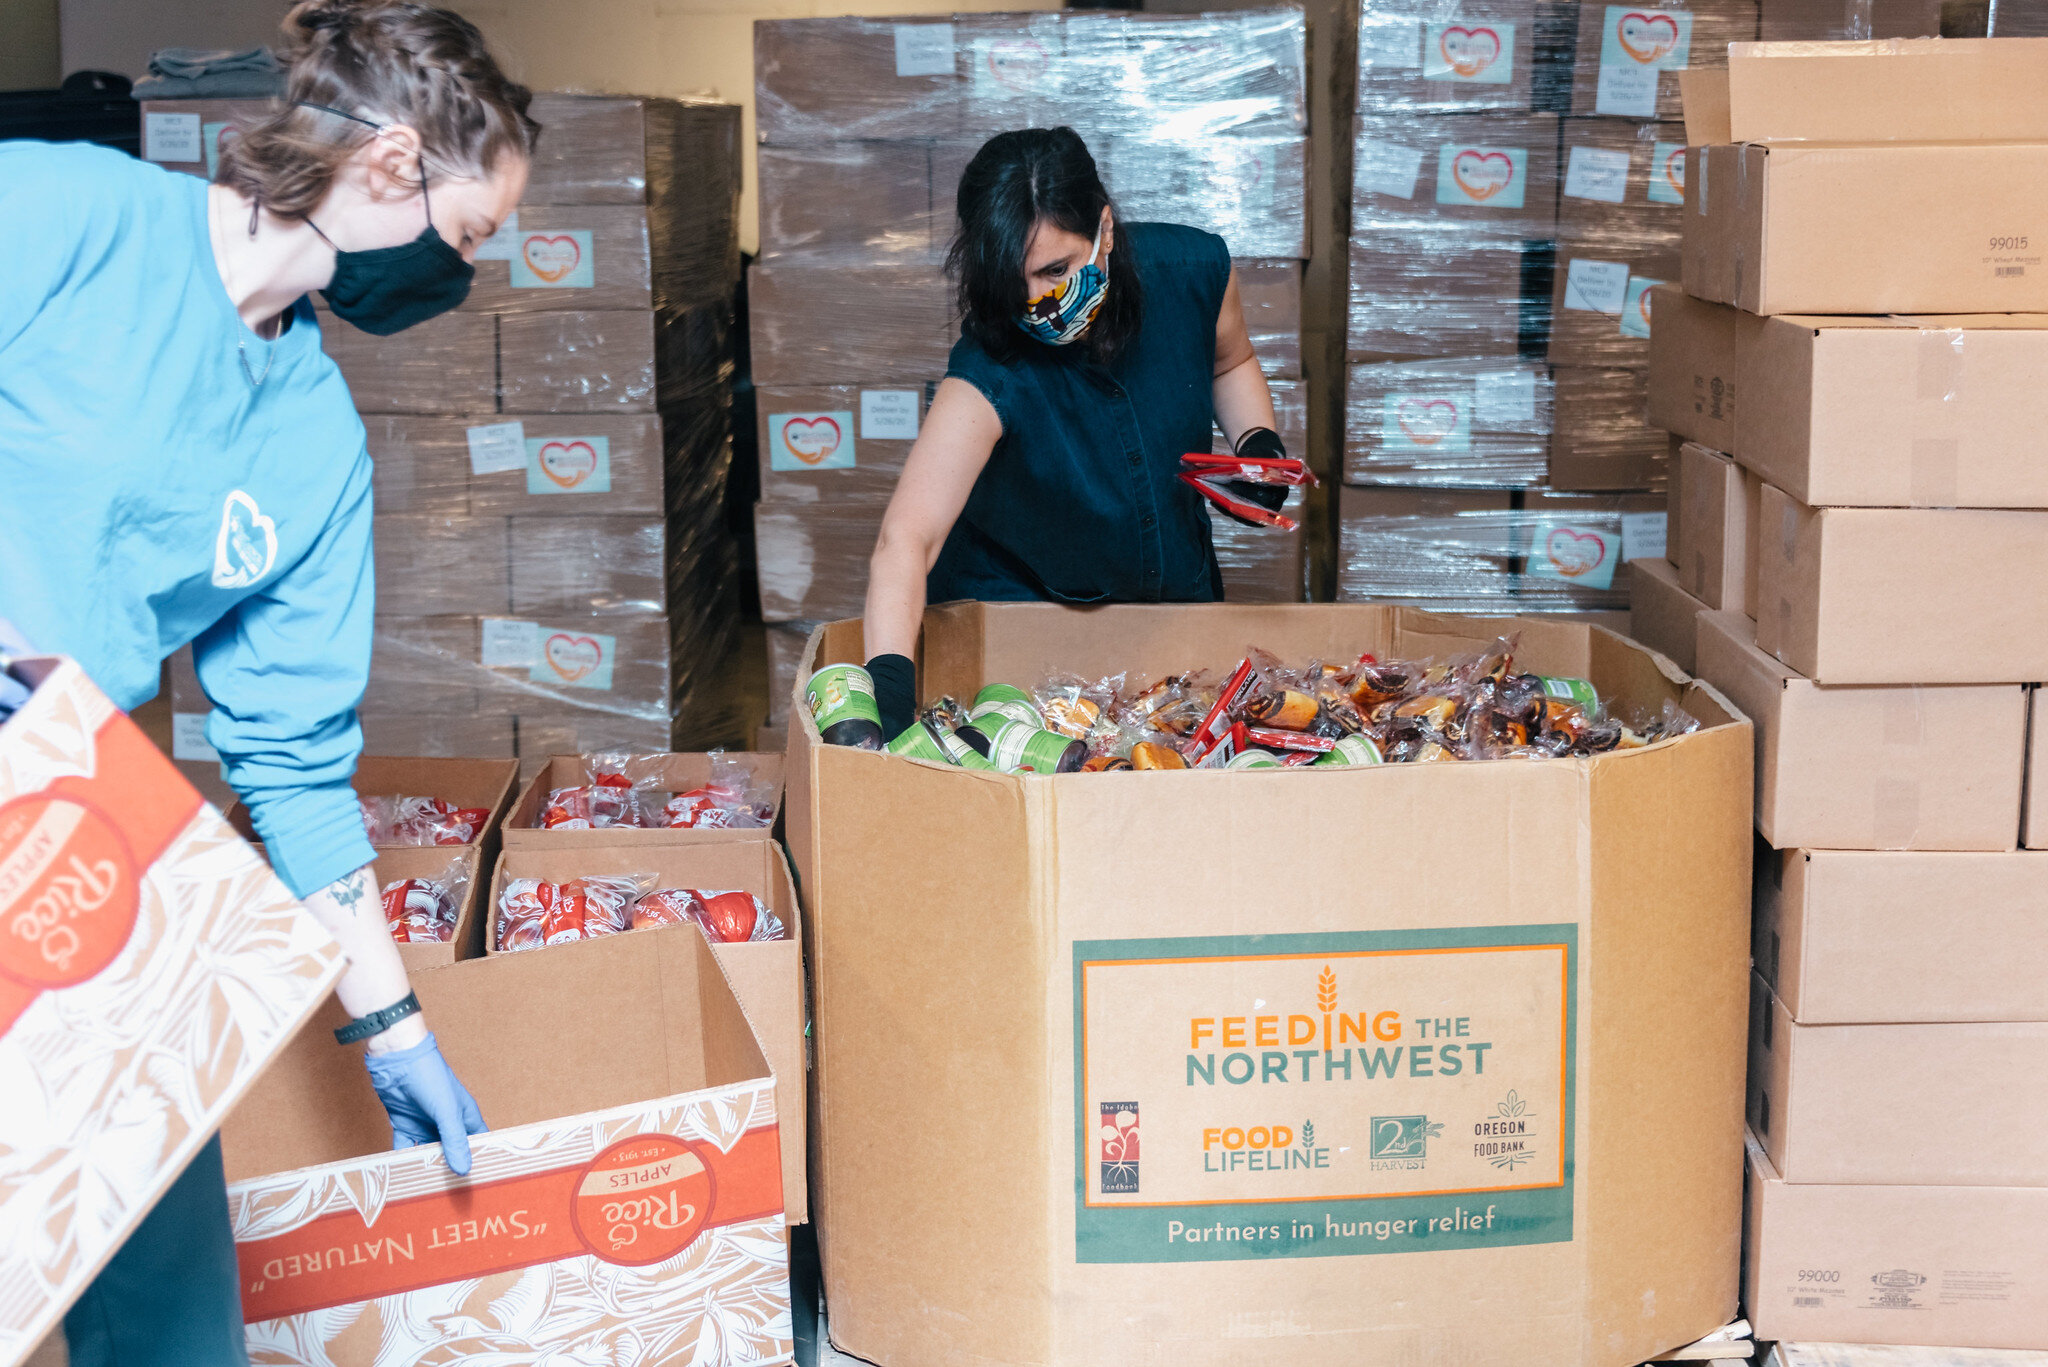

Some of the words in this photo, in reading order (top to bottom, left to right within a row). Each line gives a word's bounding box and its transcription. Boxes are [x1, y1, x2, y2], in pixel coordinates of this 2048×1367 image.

[1989, 237, 2028, 251] 99015
[10, 853, 118, 941] Rice
[1190, 1009, 1402, 1053] FEEDING
[1415, 1016, 1471, 1038] THE
[1186, 1042, 1493, 1086] NORTHWEST
[1203, 1125, 1294, 1151] FOOD
[1474, 1121, 1525, 1136] OREGON
[619, 1151, 639, 1162] 1913
[1204, 1148, 1330, 1172] LIFELINE
[1474, 1142, 1499, 1157] FOOD
[1500, 1141, 1525, 1154] BANK
[609, 1163, 672, 1188] APPLES
[1370, 1159, 1428, 1171] HARVEST
[601, 1189, 696, 1230] Rice
[1168, 1220, 1281, 1243] Partners
[1292, 1218, 1314, 1239] in
[1325, 1213, 1418, 1241] hunger
[1428, 1204, 1496, 1232] relief
[1797, 1269, 1840, 1283] 99000
